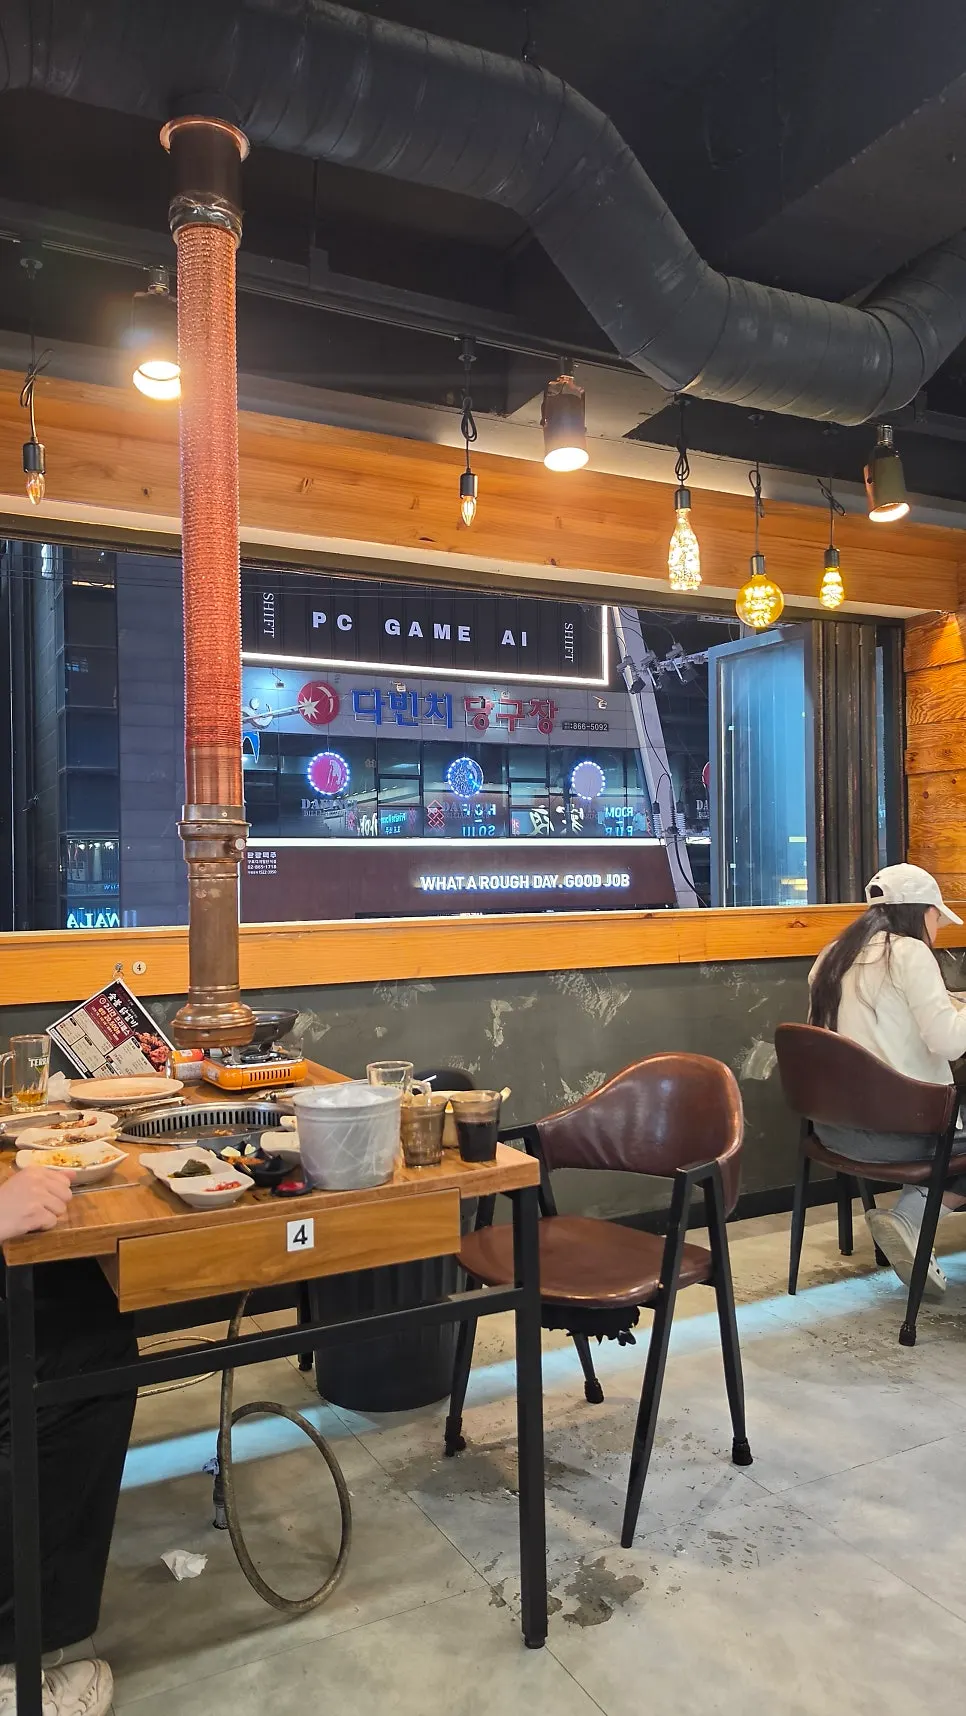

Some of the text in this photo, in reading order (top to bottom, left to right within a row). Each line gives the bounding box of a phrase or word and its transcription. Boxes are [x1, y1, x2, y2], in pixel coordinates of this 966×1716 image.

[262, 592, 275, 639] SHIFT
[312, 611, 528, 647] PC GAME AI
[563, 622, 575, 663] SHIFT
[351, 687, 559, 735] 다빈치 당구장
[420, 873, 630, 891] WHAT A ROUGH DAY. GOOD JOB
[136, 963, 142, 972] 4
[119, 1006, 139, 1028] 닭갈비
[292, 1223, 309, 1245] 4
